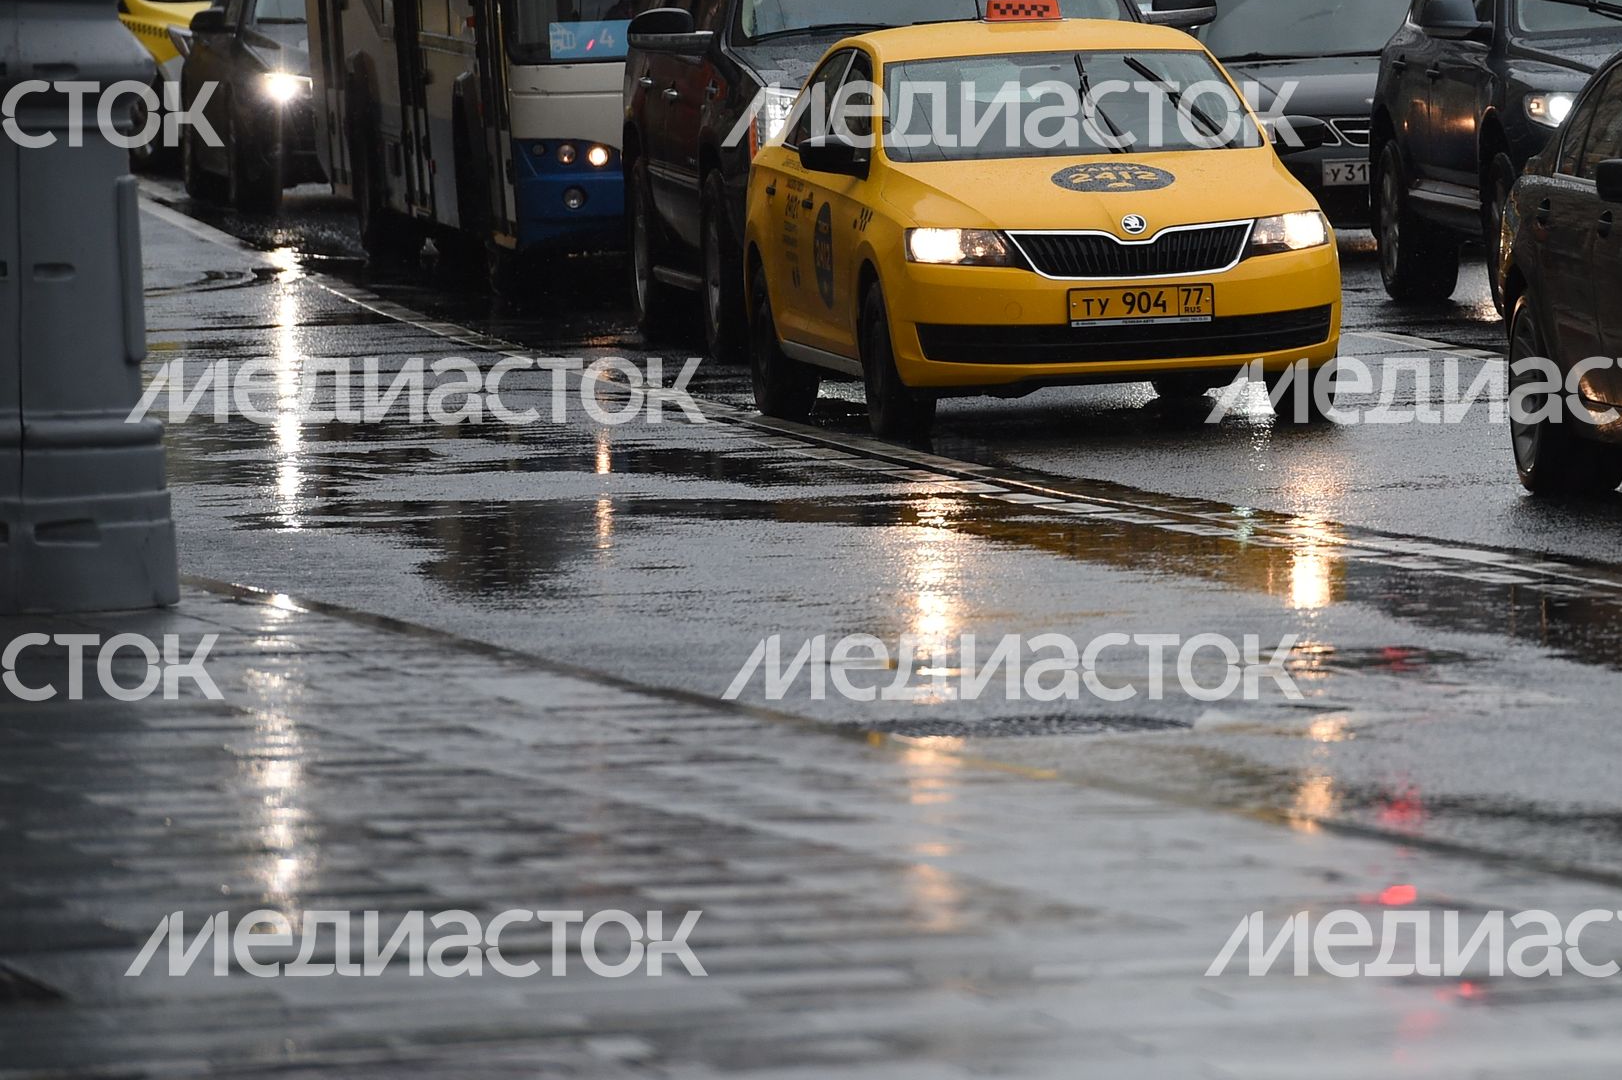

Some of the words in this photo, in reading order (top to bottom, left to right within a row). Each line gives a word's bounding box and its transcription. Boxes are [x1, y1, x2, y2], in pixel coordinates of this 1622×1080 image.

[1068, 171, 1159, 184] 2412
[1082, 298, 1110, 317] ТУ
[1122, 291, 1167, 315] 904
[1181, 288, 1204, 306] 77
